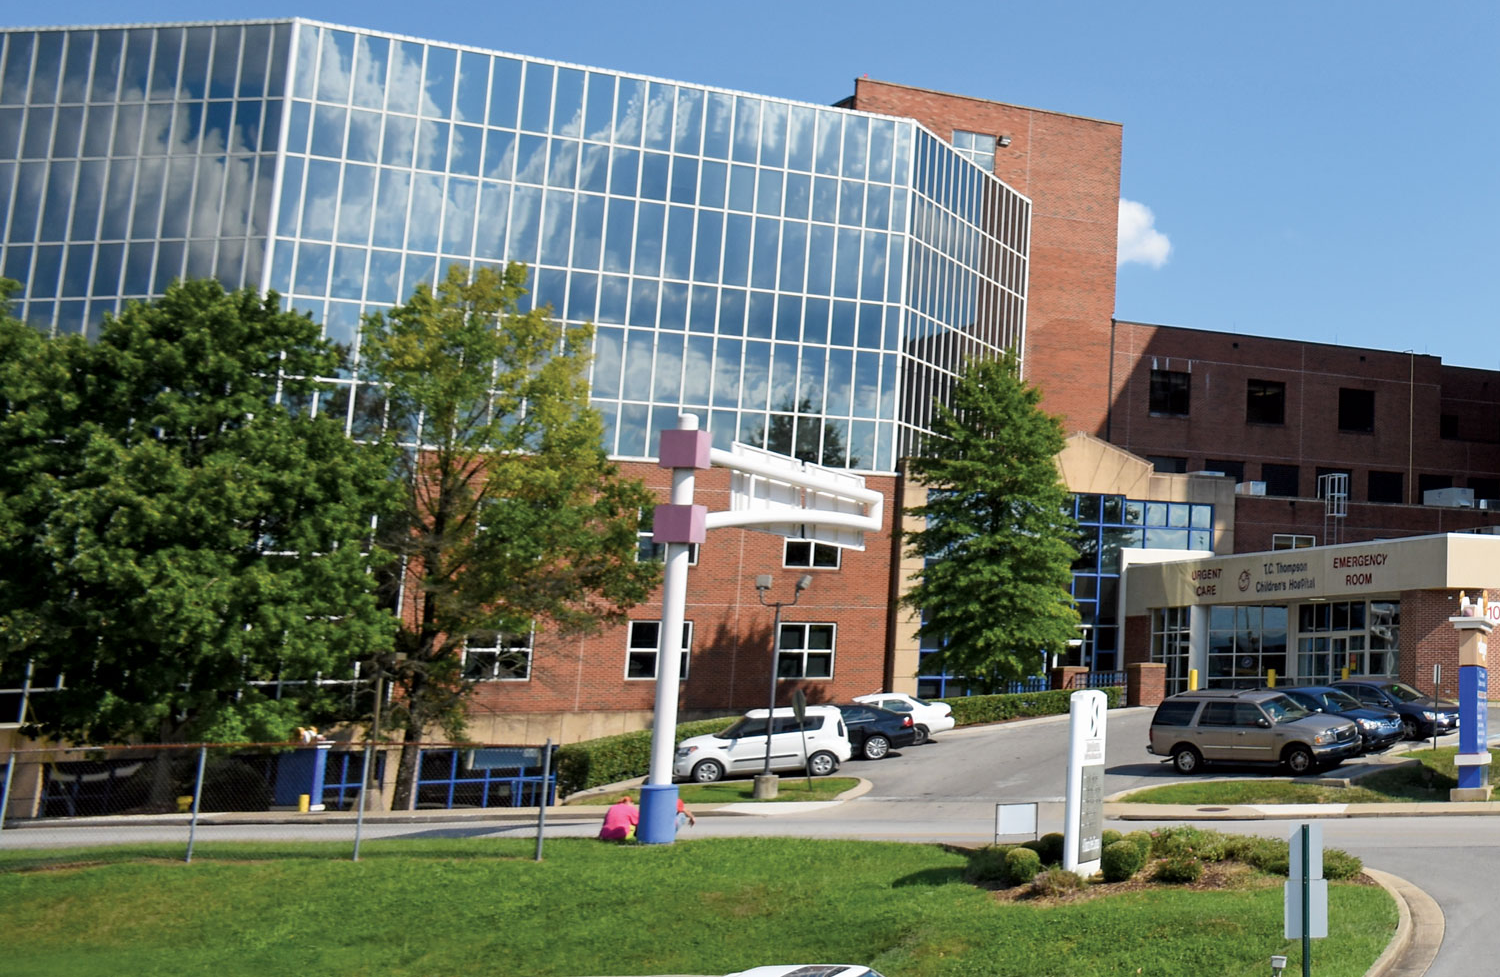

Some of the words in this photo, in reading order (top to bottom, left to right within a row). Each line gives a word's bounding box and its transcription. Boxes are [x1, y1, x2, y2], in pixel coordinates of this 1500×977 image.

[1333, 553, 1388, 569] EMERGENCY
[1191, 568, 1222, 581] URGENT
[1276, 562, 1308, 575] Thompson
[1346, 573, 1372, 586] ROOM
[1196, 585, 1216, 597] CARE
[1256, 580, 1286, 593] Children's
[1487, 605, 1500, 620] 10
